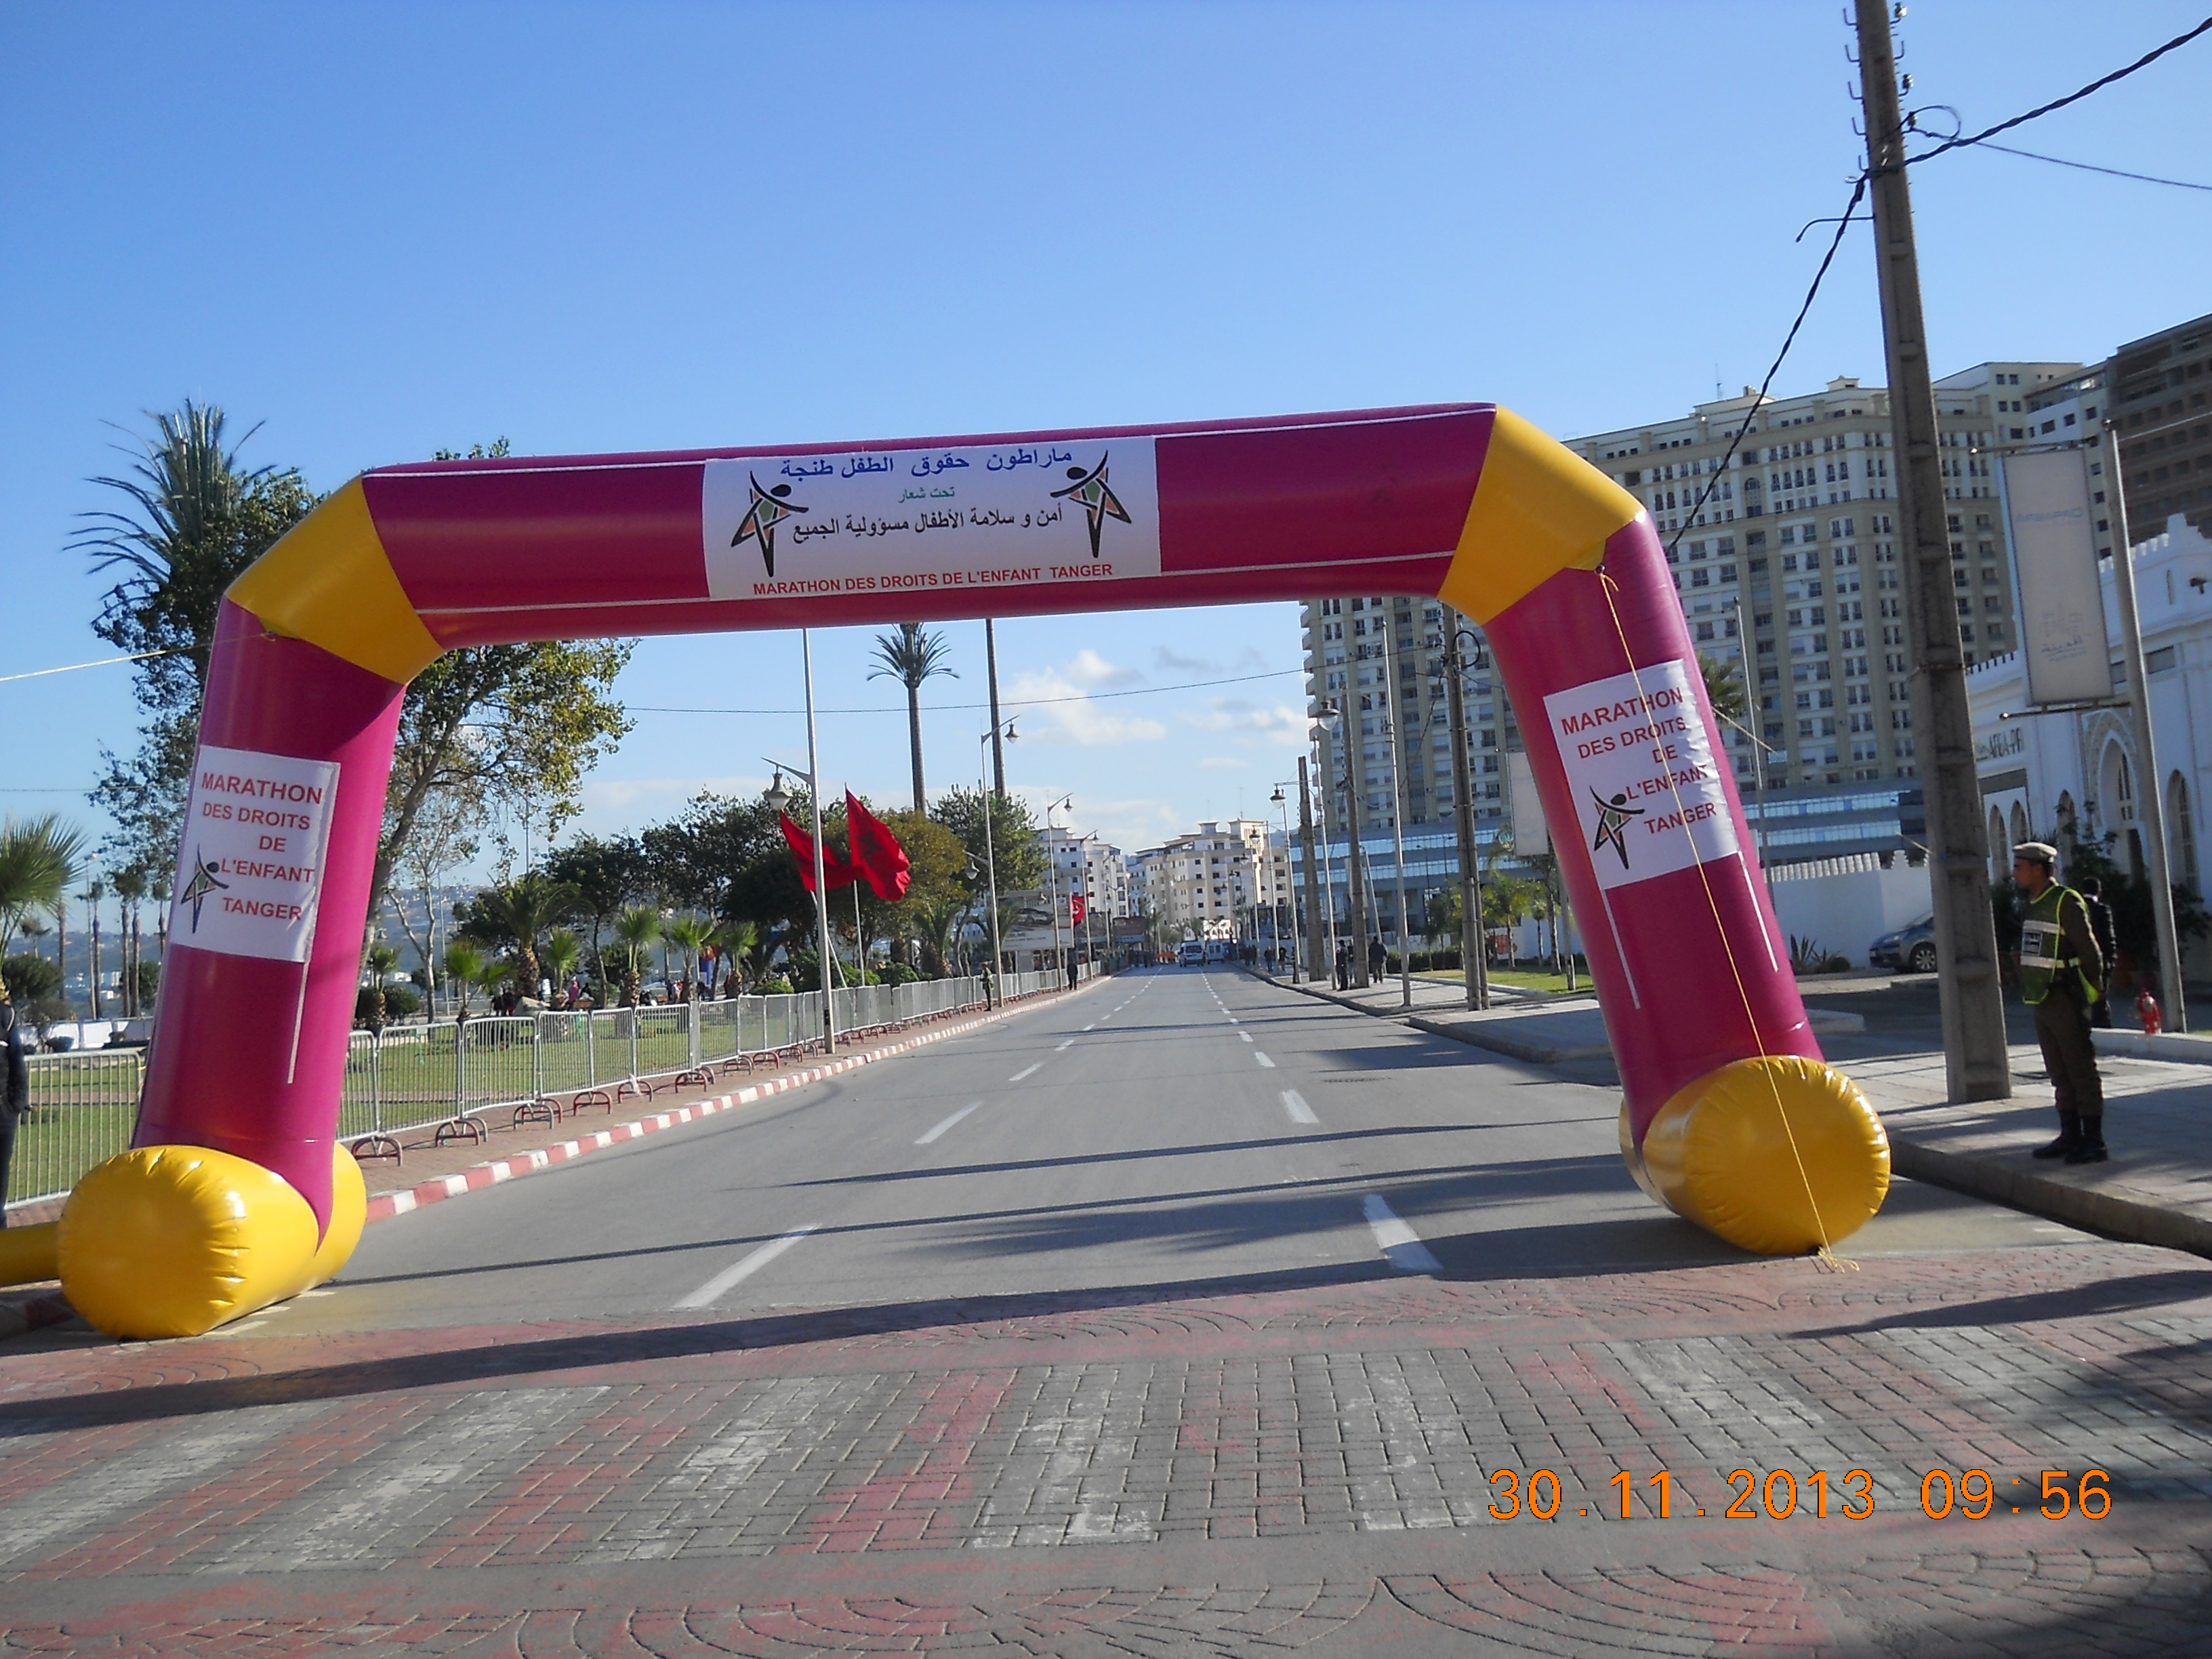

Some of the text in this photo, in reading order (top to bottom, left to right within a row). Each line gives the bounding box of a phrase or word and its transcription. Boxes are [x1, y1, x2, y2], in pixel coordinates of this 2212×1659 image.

[781, 448, 1072, 482] ماراطون حقوق الطفل طنجة
[898, 487, 955, 503] تحت شعار
[793, 502, 1062, 544] أمن و سلامة الأطفال مسؤولية الجميع
[753, 564, 1112, 594] MARATHON DES DROITS DE L'ENFANT TANGER
[1561, 687, 1684, 735] MARATHON
[1578, 717, 1686, 759] DES DROITS
[1652, 745, 1678, 763] DE
[202, 773, 322, 804] MARATHON
[1627, 765, 1709, 800] L'ENFANT
[203, 802, 310, 830] DES DROITS
[1644, 802, 1717, 834] TANGER
[259, 836, 286, 852] DE
[221, 858, 314, 882] L'ENFANT
[223, 897, 302, 920] TANGER
